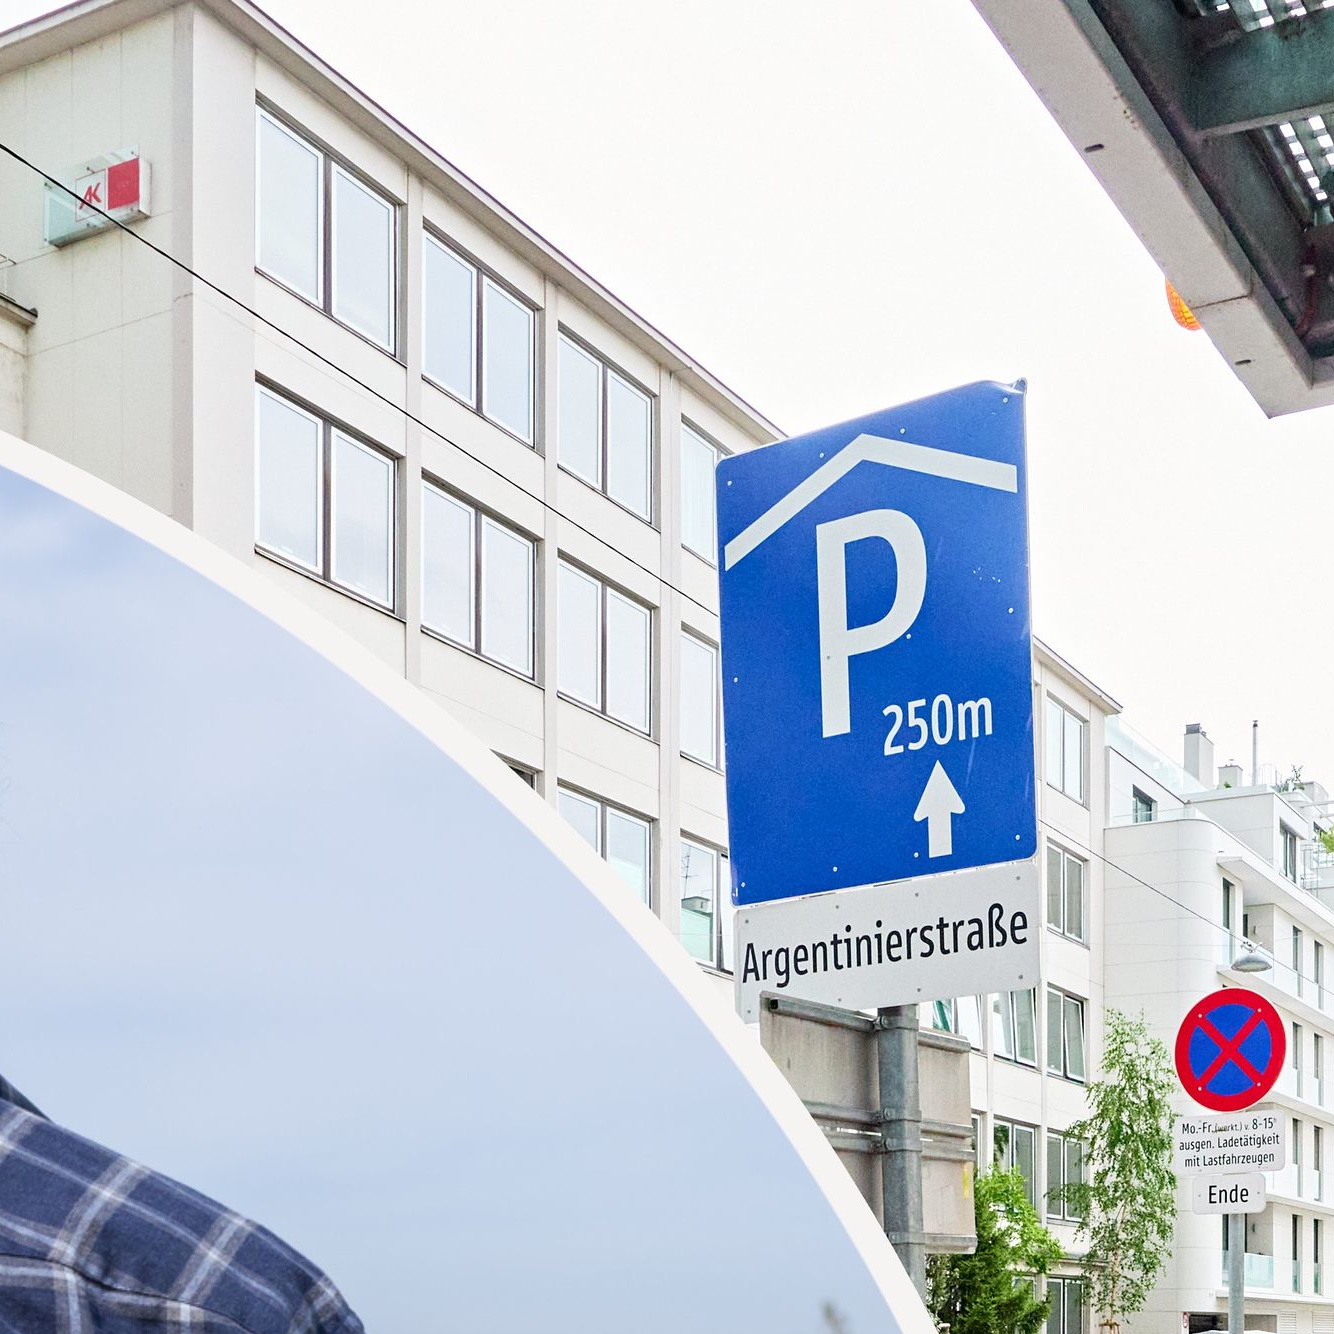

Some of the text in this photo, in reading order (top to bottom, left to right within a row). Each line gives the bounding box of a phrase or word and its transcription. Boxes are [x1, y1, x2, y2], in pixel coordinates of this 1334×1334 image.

[78, 182, 102, 210] AK
[816, 508, 927, 738] P
[882, 693, 993, 756] 250m
[742, 902, 1028, 988] Argentinierstraße
[1179, 1132, 1280, 1152] ausgen. Ladetätigkeit
[1185, 1152, 1275, 1167] mit Lastfahrzeugen
[1208, 1184, 1249, 1204] Ende
